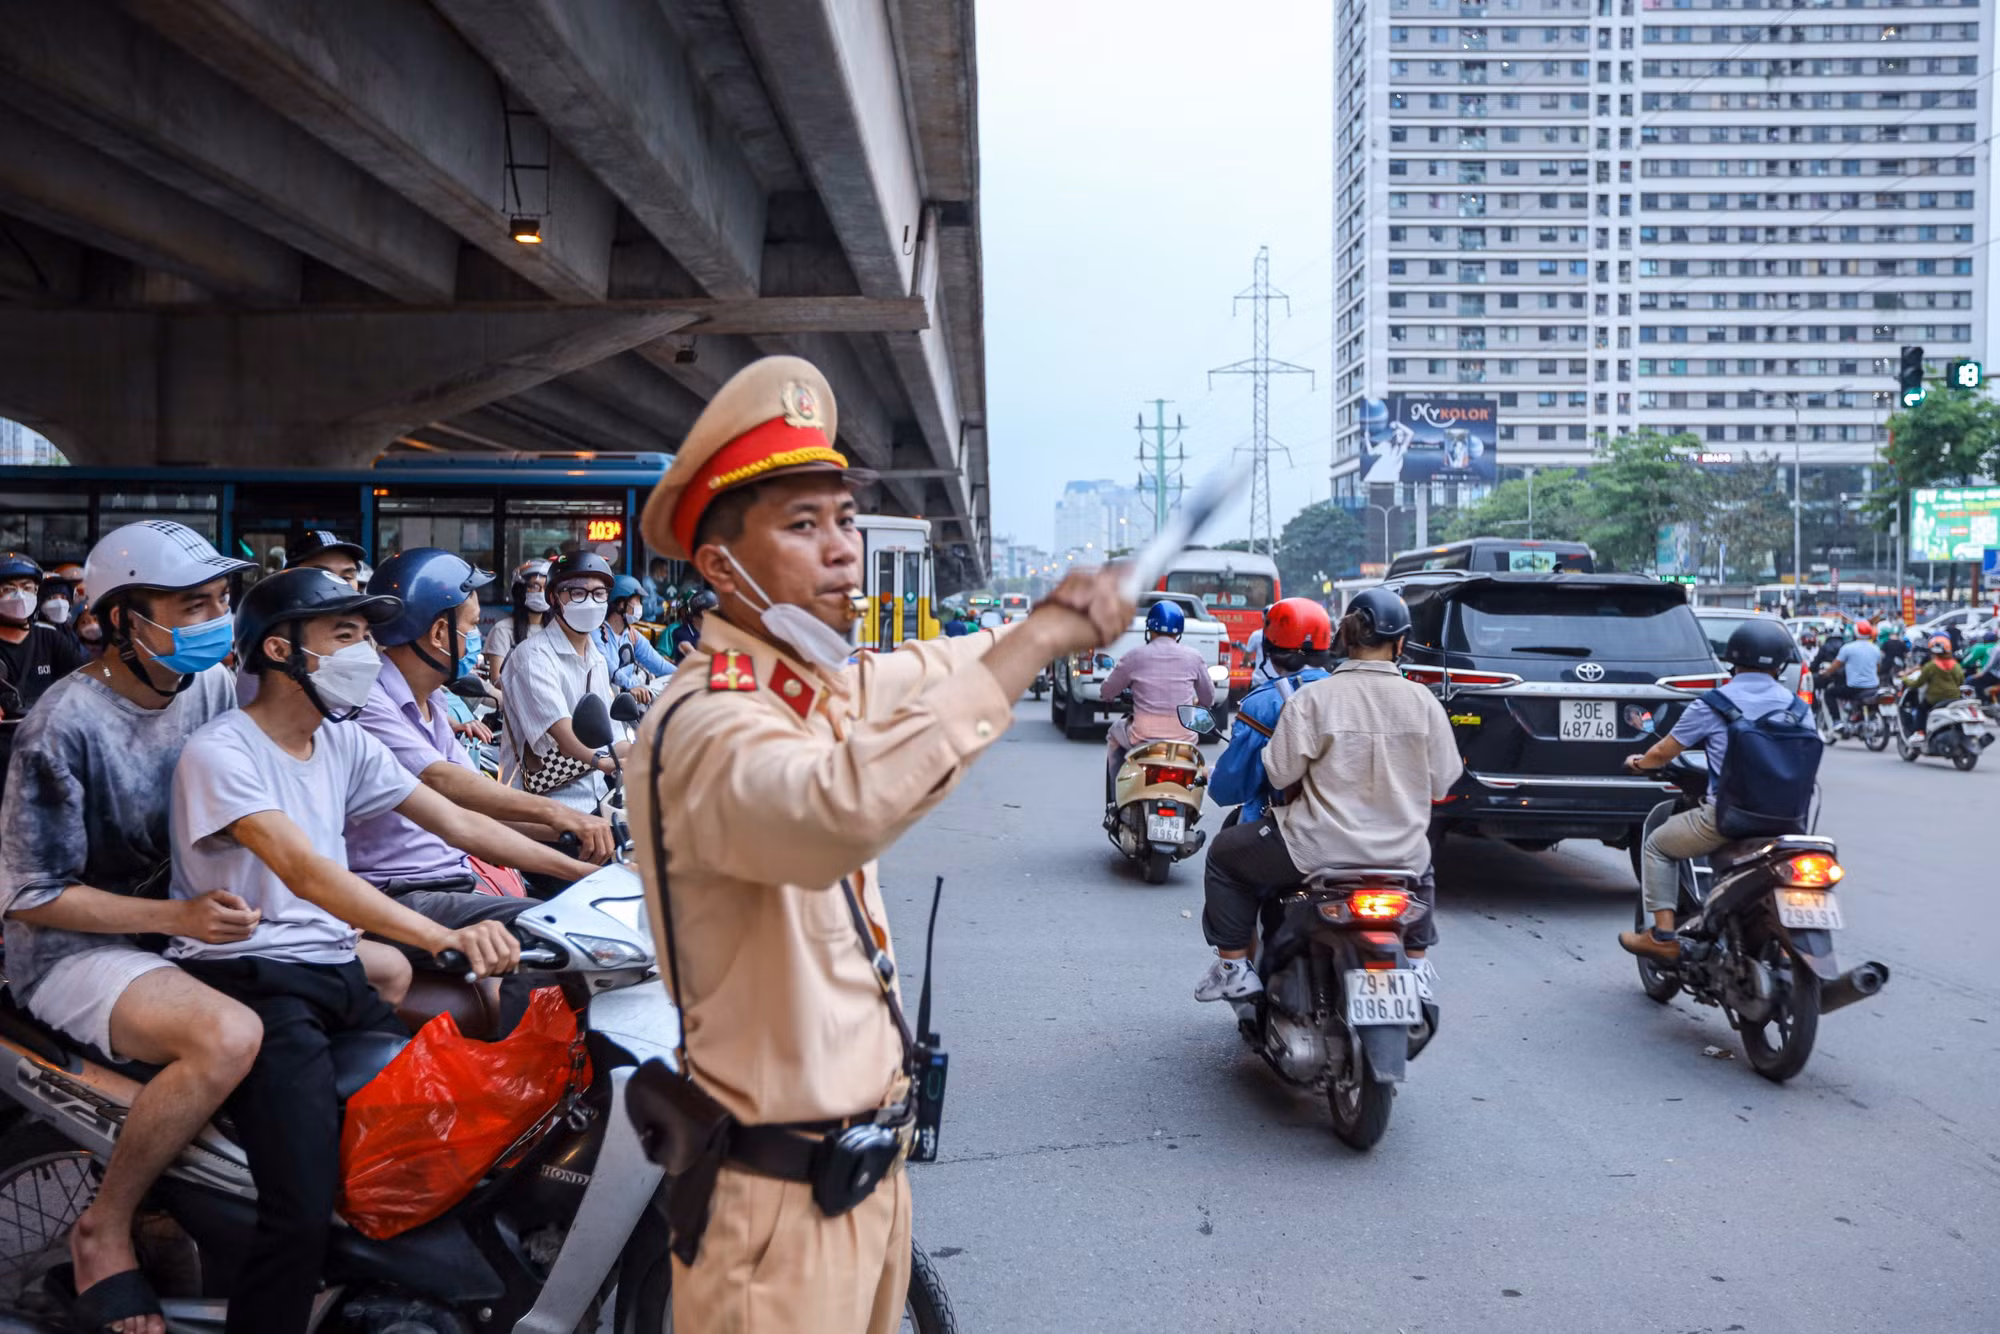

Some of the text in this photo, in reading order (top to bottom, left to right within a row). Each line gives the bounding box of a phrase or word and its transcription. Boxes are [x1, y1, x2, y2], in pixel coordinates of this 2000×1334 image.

[588, 520, 621, 541] 103A
[1573, 702, 1603, 719] 30E
[1562, 721, 1615, 739] 487.48
[1356, 974, 1406, 996] 29-N1
[1353, 998, 1416, 1020] 886.04
[542, 1165, 591, 1185] HOND
